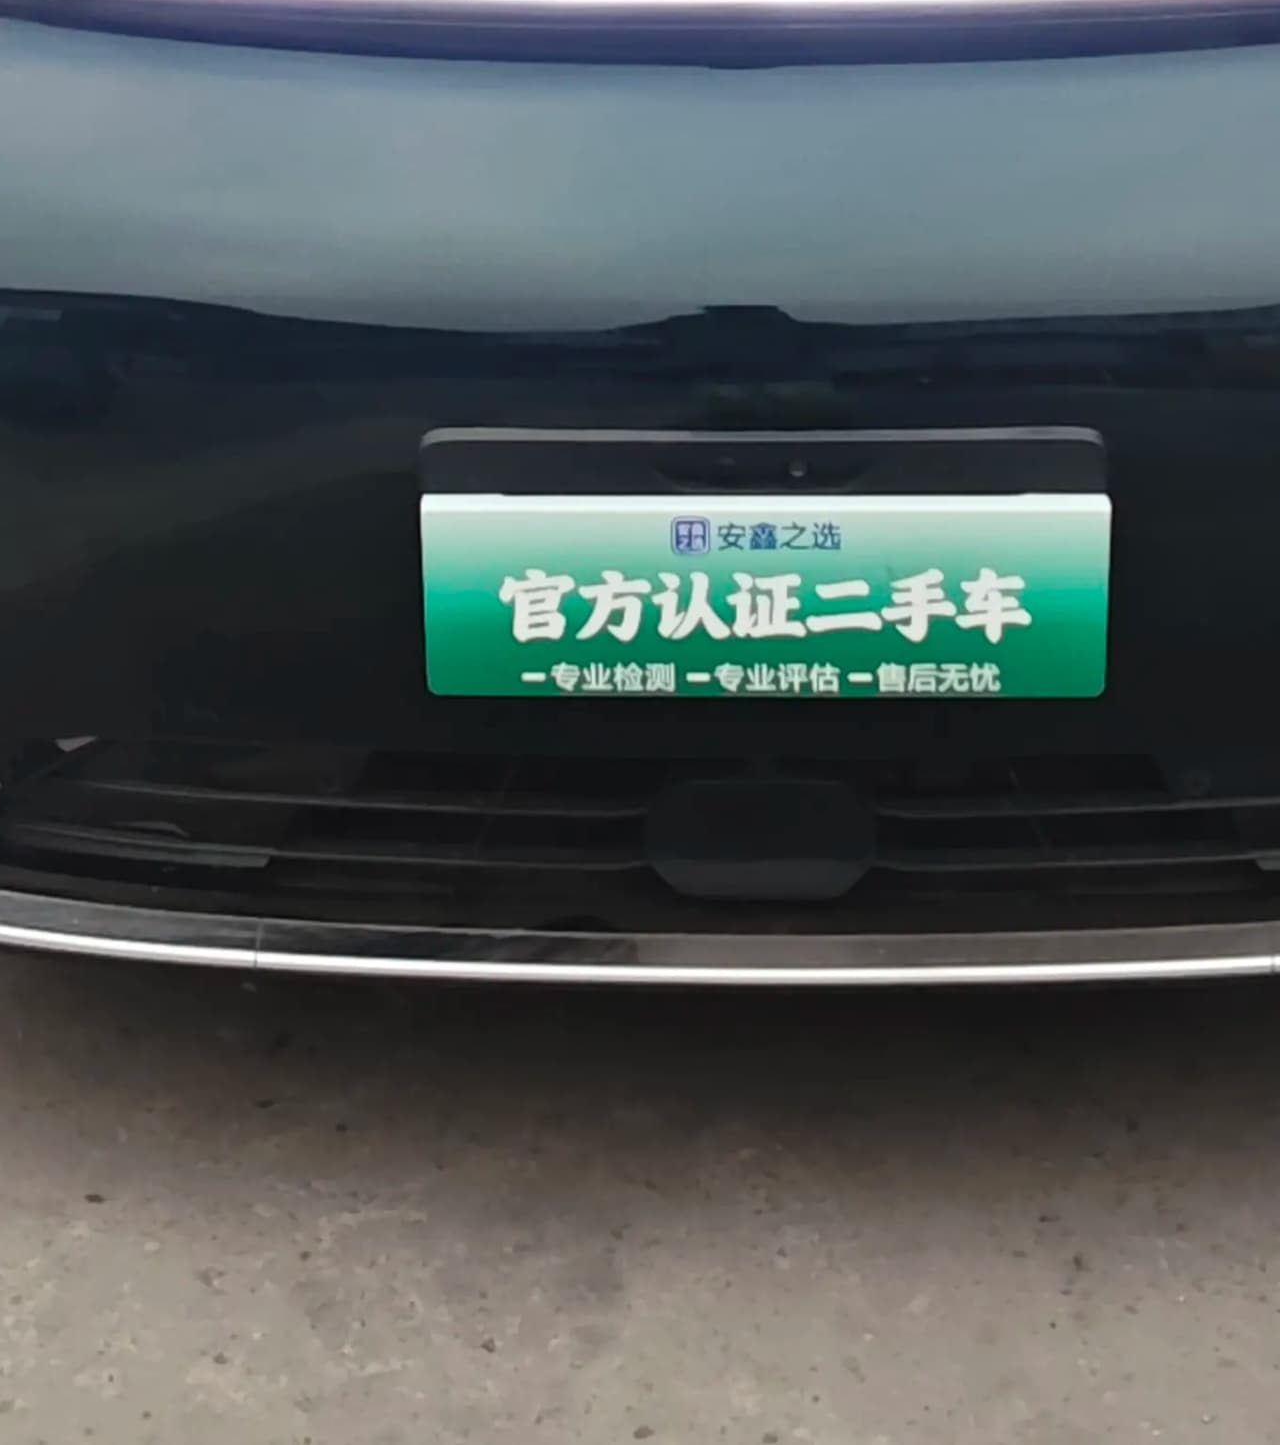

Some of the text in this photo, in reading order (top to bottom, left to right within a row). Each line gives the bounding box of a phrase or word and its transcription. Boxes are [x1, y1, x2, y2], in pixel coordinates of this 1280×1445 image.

[717, 521, 842, 552] 安鑫之选
[498, 567, 1033, 645] 官方认证二手车
